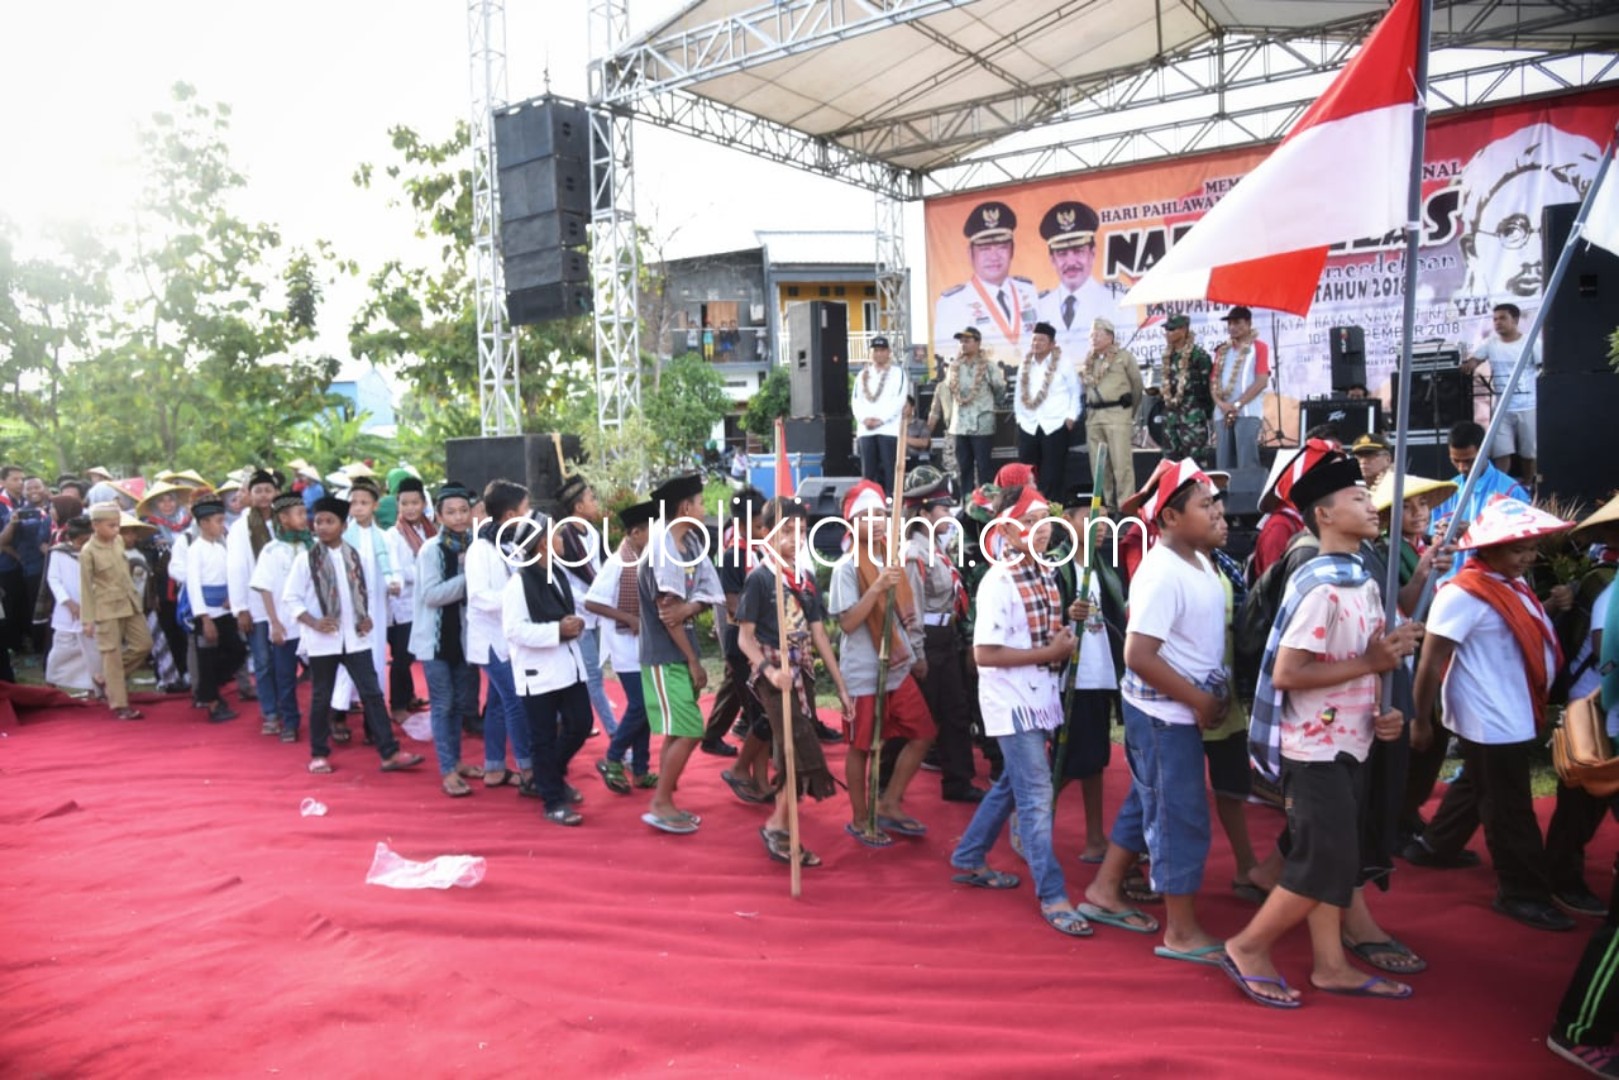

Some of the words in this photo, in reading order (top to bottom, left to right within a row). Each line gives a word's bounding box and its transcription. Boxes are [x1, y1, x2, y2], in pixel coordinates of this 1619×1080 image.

[1101, 207, 1137, 223] HARI
[1423, 161, 1462, 179] NAL
[1206, 176, 1243, 194] MEM
[1315, 278, 1368, 301] TAHUN
[1372, 277, 1407, 298] 2018
[1427, 322, 1460, 336] 2018
